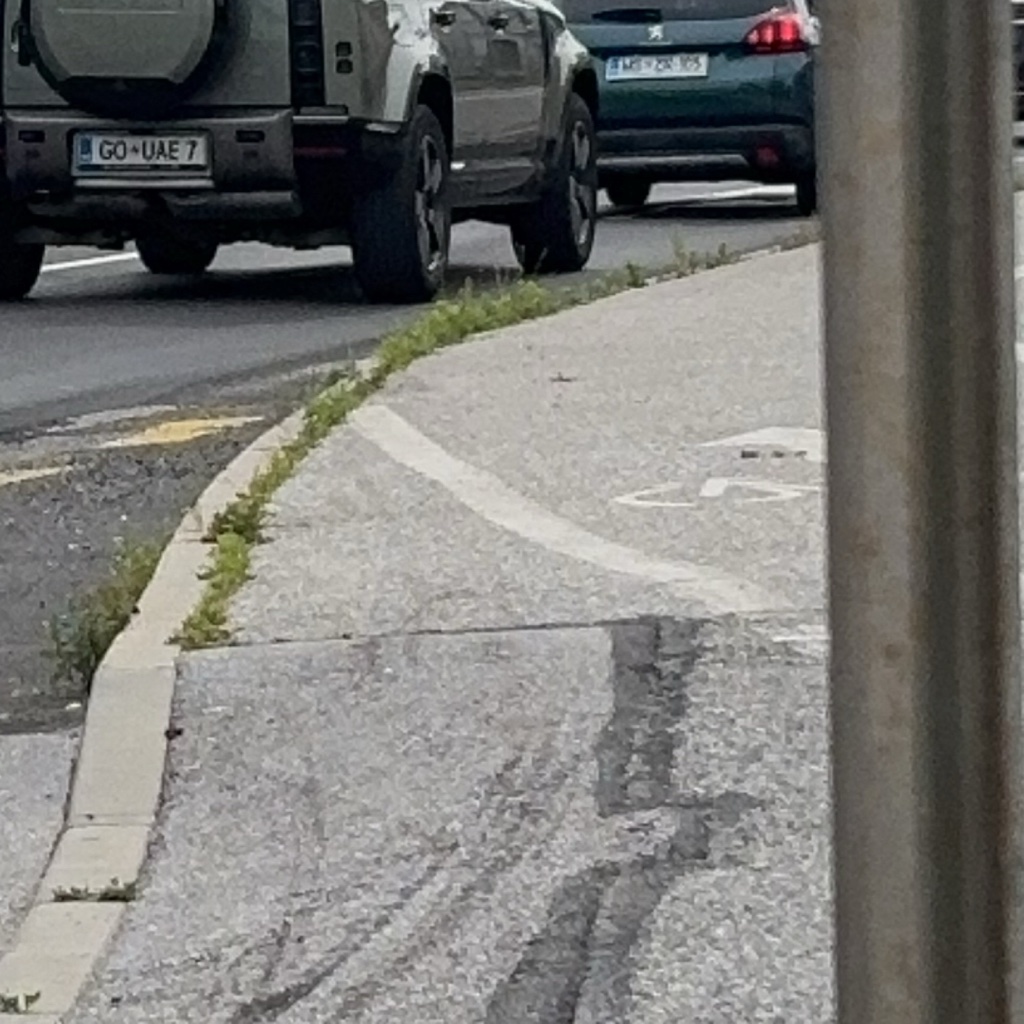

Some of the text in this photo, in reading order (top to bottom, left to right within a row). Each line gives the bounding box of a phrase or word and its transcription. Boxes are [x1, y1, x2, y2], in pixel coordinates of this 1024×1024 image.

[99, 139, 198, 161] GO UAE 7
